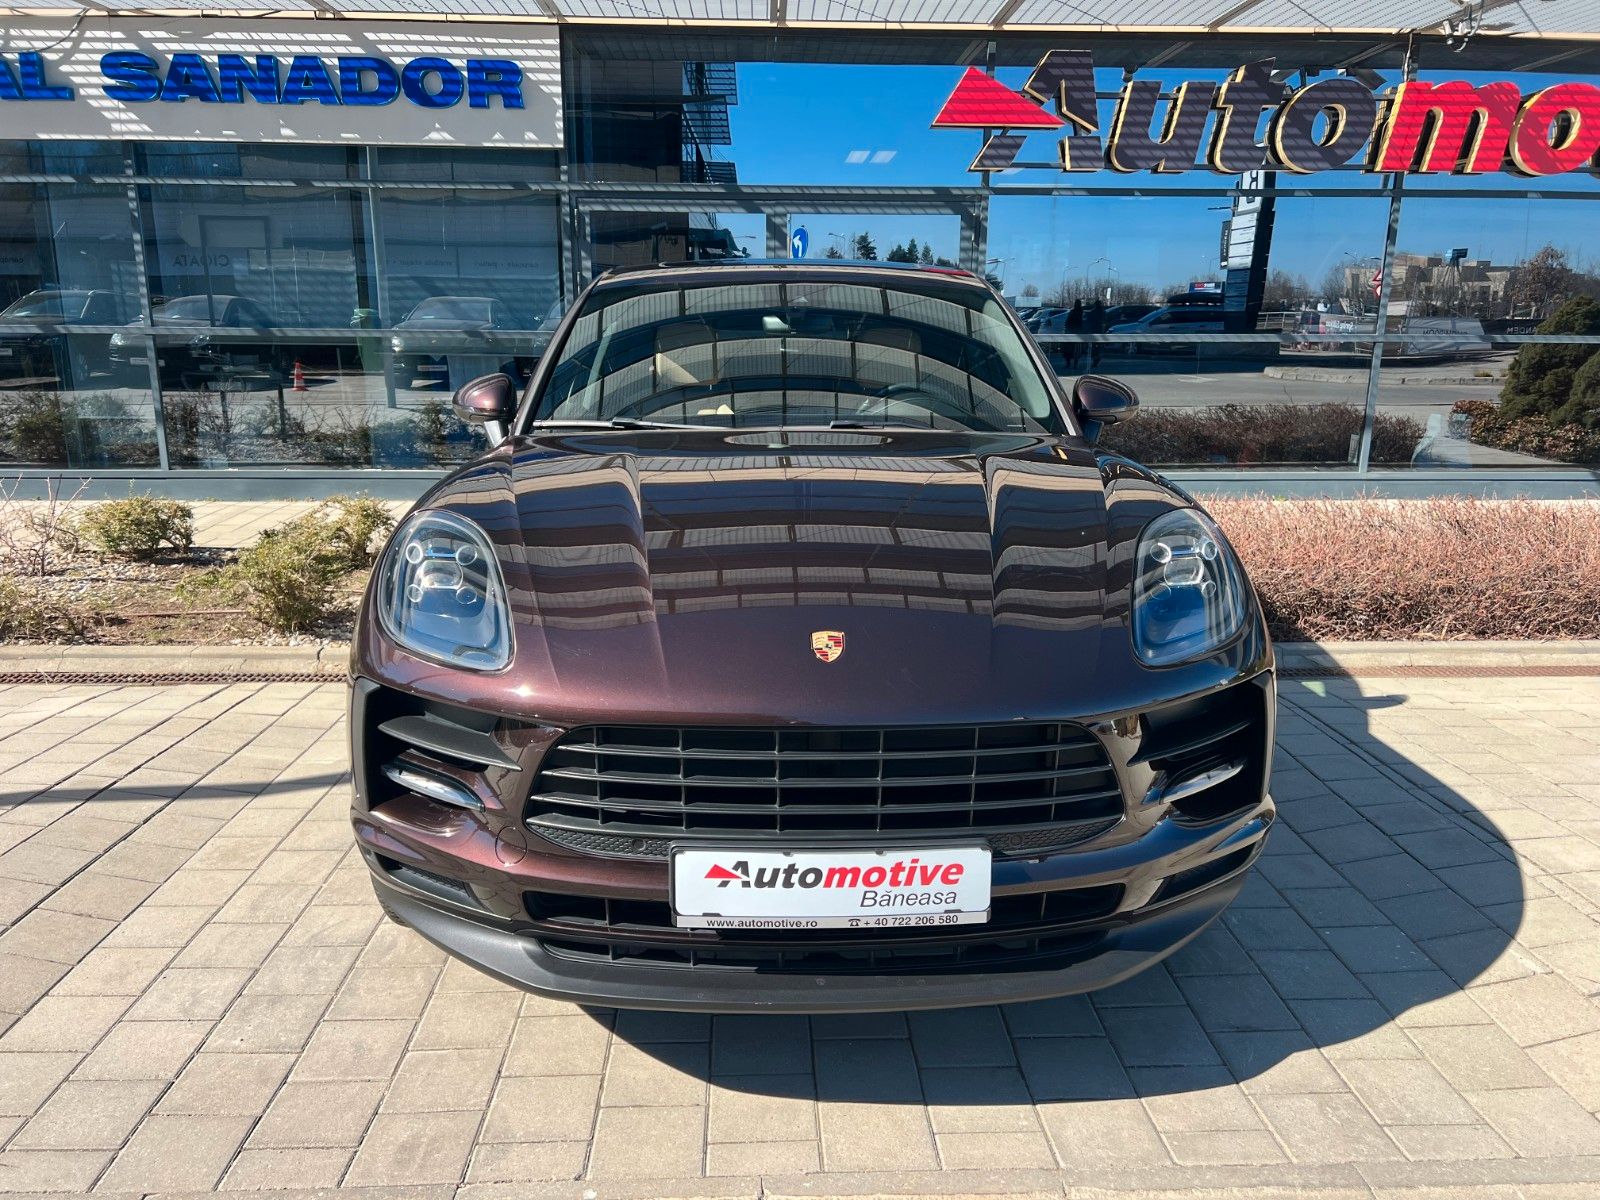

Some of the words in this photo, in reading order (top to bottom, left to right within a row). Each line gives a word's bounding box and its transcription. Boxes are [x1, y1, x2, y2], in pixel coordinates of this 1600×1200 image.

[101, 51, 525, 110] SANADOR
[712, 858, 964, 889] Automotive
[860, 889, 957, 908] Băneasa
[706, 918, 818, 929] www.automotive.ro
[874, 917, 888, 927] 40
[892, 916, 912, 927] 722
[915, 915, 936, 926] 206
[939, 914, 959, 925] 580
